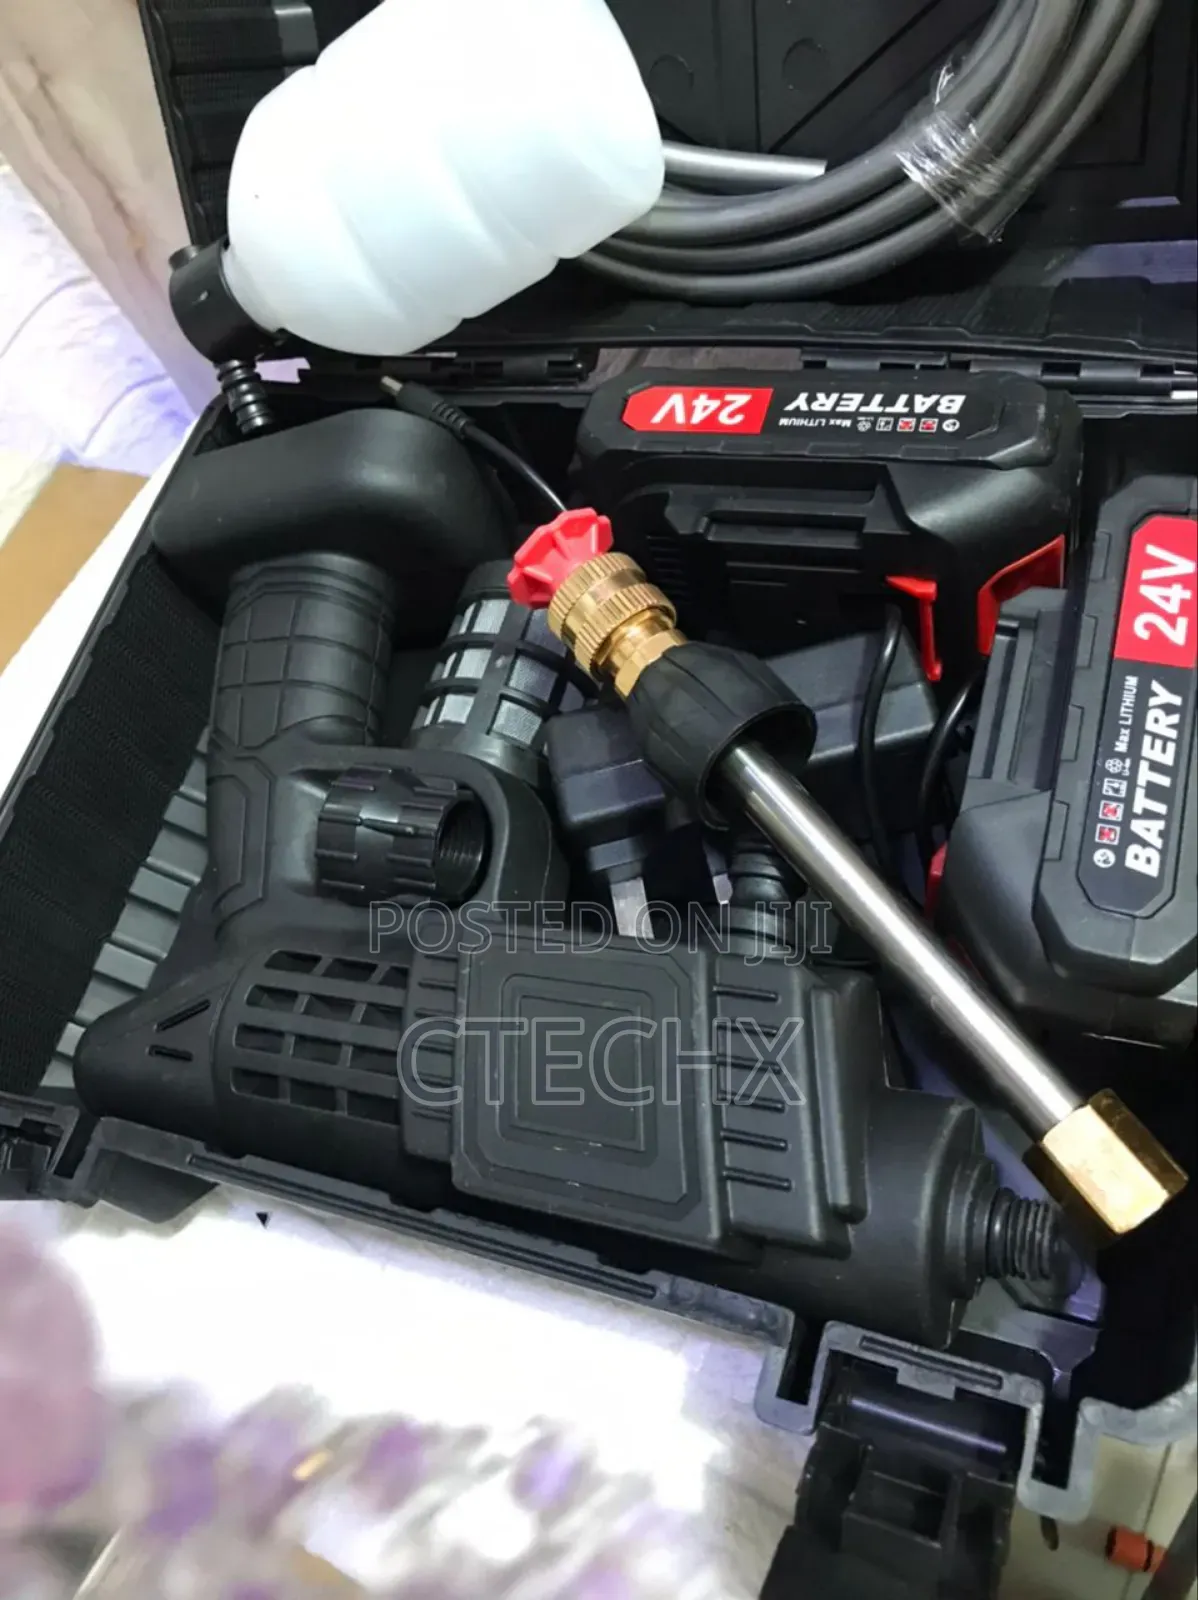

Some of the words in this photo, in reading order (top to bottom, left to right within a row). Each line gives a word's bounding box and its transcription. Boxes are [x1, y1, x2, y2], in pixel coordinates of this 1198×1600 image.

[651, 394, 751, 424] 24V
[784, 392, 966, 413] BATTERY
[778, 417, 826, 427] LITHIUM
[829, 418, 852, 428] Max
[1133, 545, 1196, 646] 24V
[1118, 675, 1139, 725] LITHIUM
[1114, 728, 1131, 753] Max
[1124, 679, 1184, 879] BATTERY
